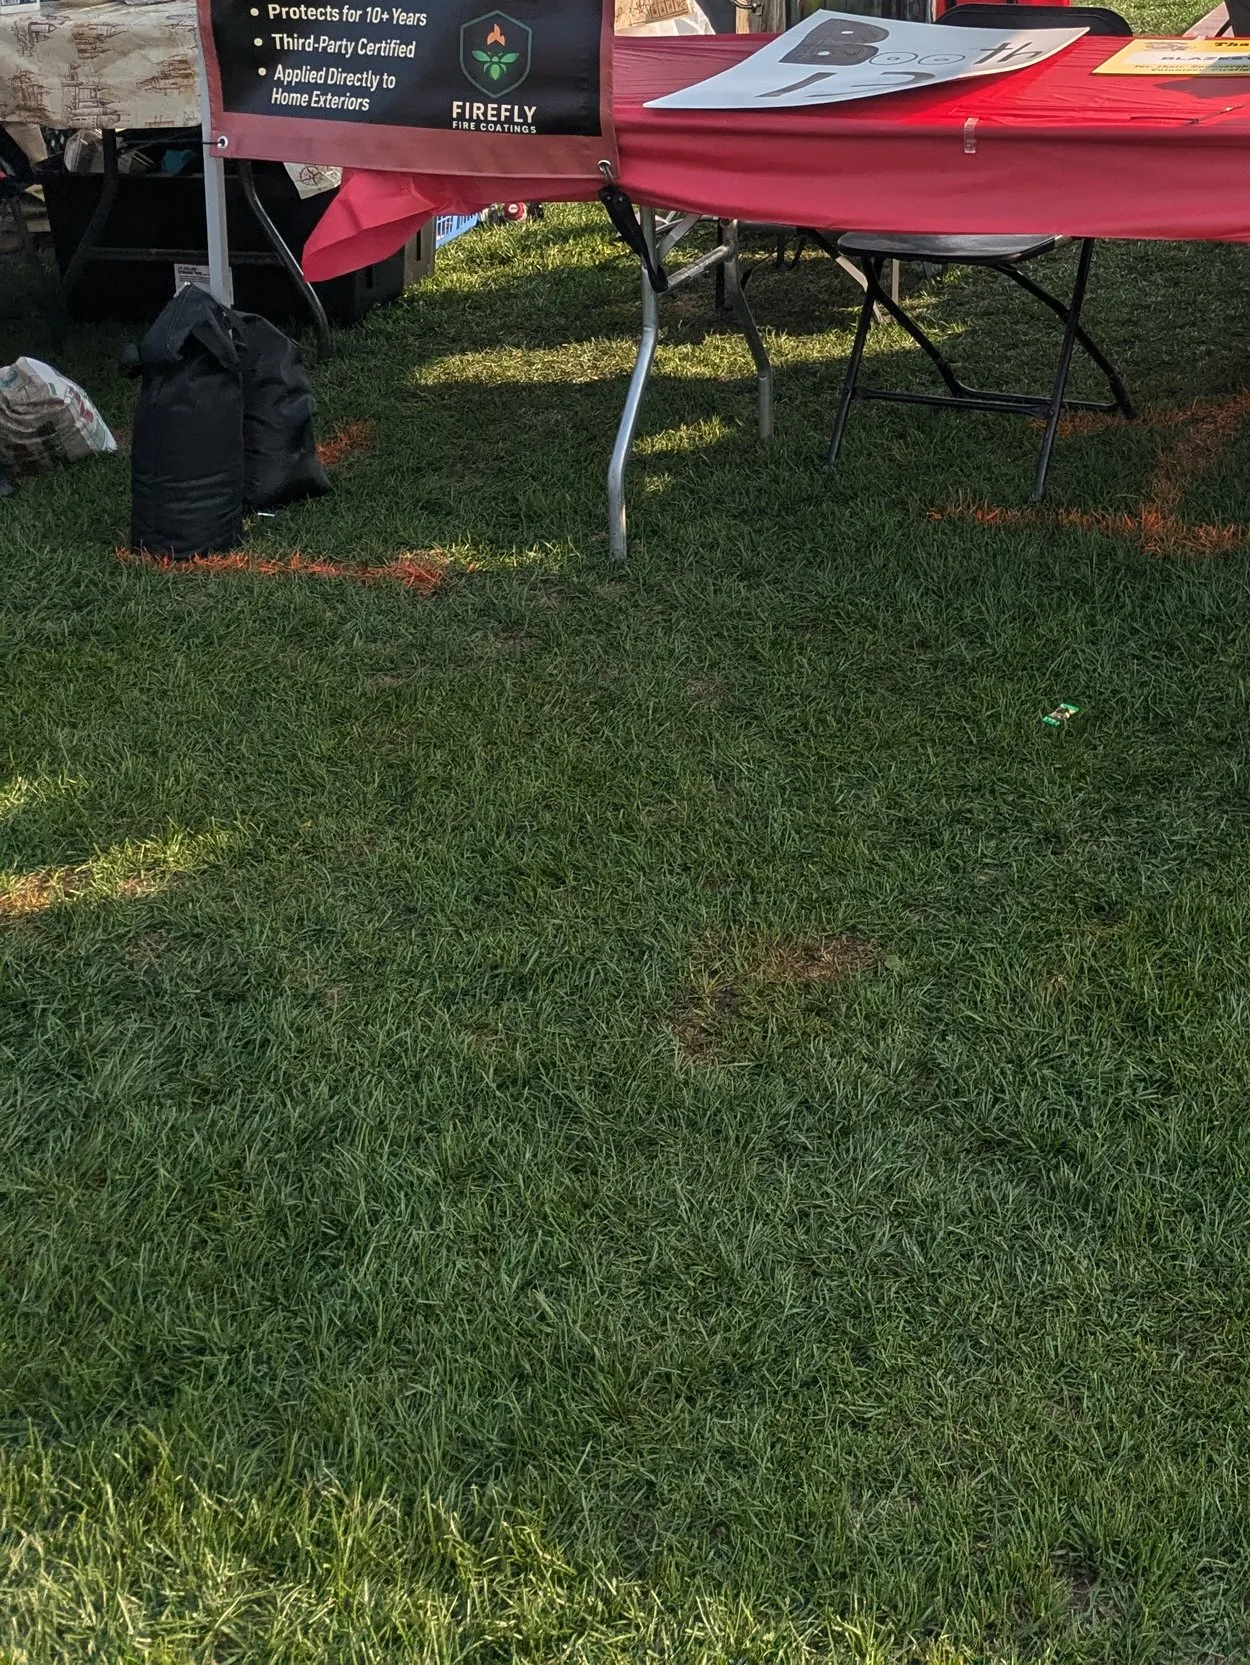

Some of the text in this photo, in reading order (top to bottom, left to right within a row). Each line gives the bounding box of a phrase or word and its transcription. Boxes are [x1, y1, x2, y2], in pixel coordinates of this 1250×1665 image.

[268, 4, 427, 26] Protects for 10+ Years
[271, 33, 416, 59] Third-Party Certified
[778, 18, 1043, 66] Booth
[273, 64, 396, 91] Applied Directly to
[271, 88, 370, 111] Home Exteriors
[452, 101, 537, 124] FIREFLY
[452, 121, 537, 134] FIRE COATINGS
